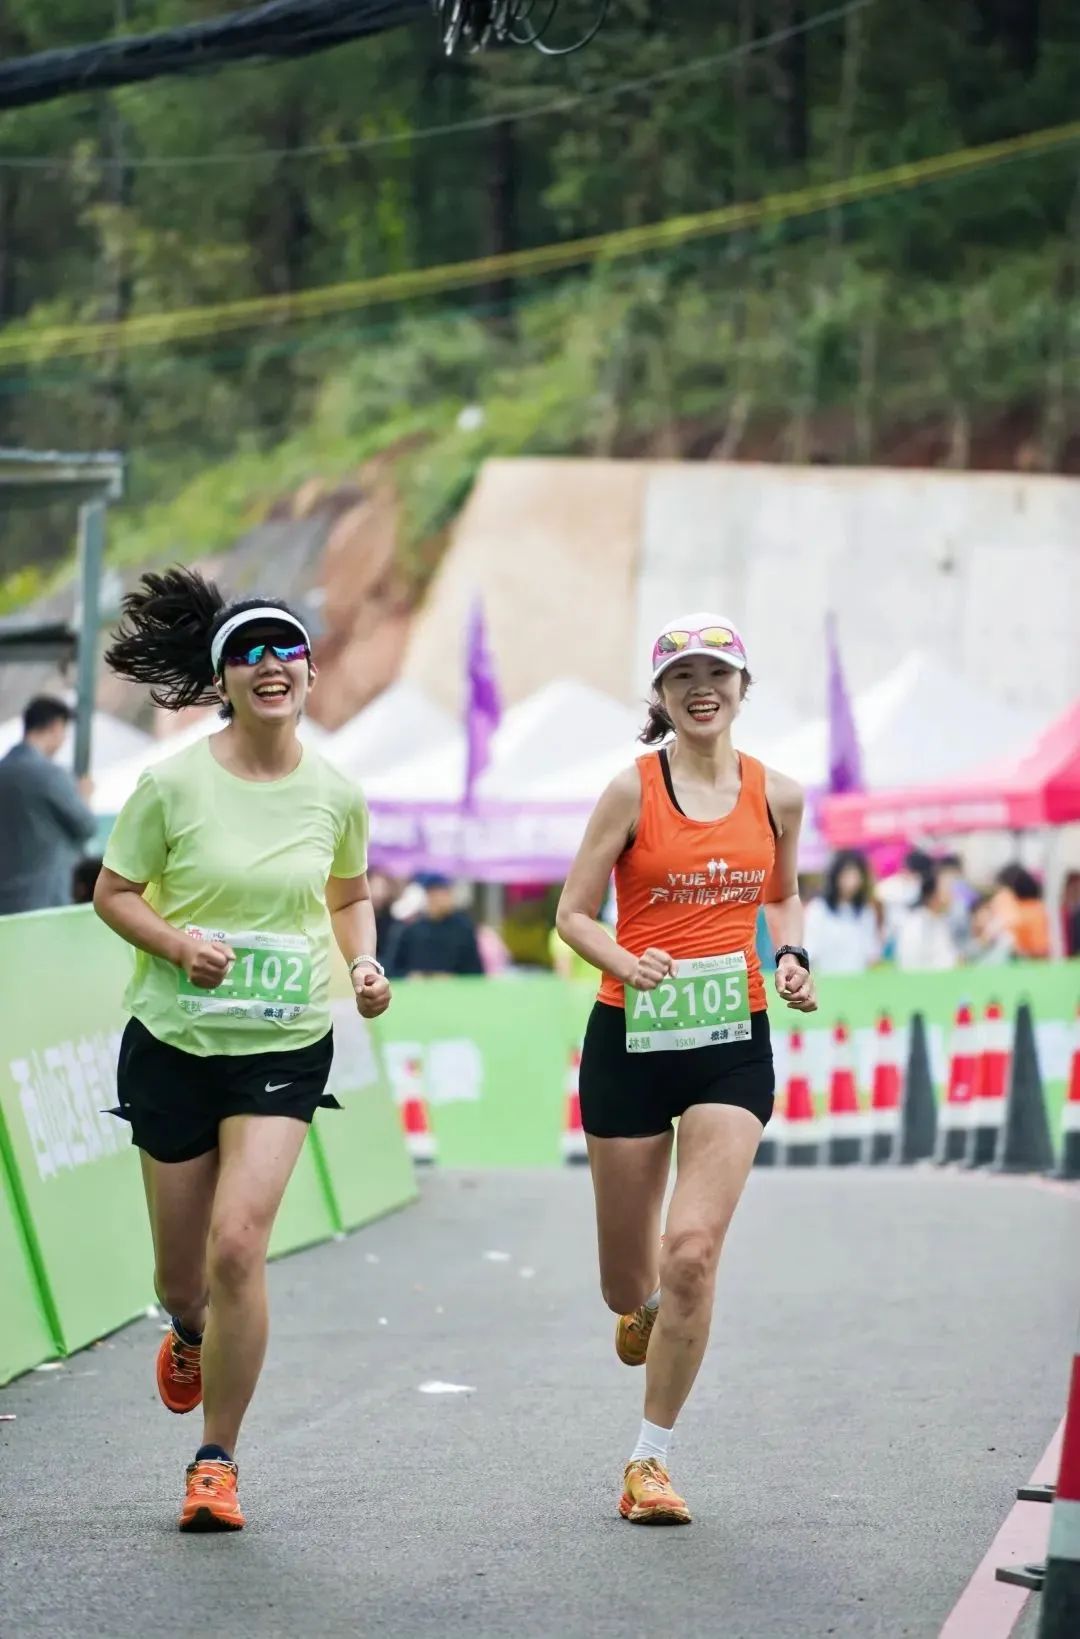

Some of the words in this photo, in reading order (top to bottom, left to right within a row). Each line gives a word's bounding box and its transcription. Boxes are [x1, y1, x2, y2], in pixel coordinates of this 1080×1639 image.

[667, 873, 707, 887] YUE
[730, 870, 766, 884] RUN
[220, 952, 304, 993] 102
[632, 976, 742, 1020] A2105
